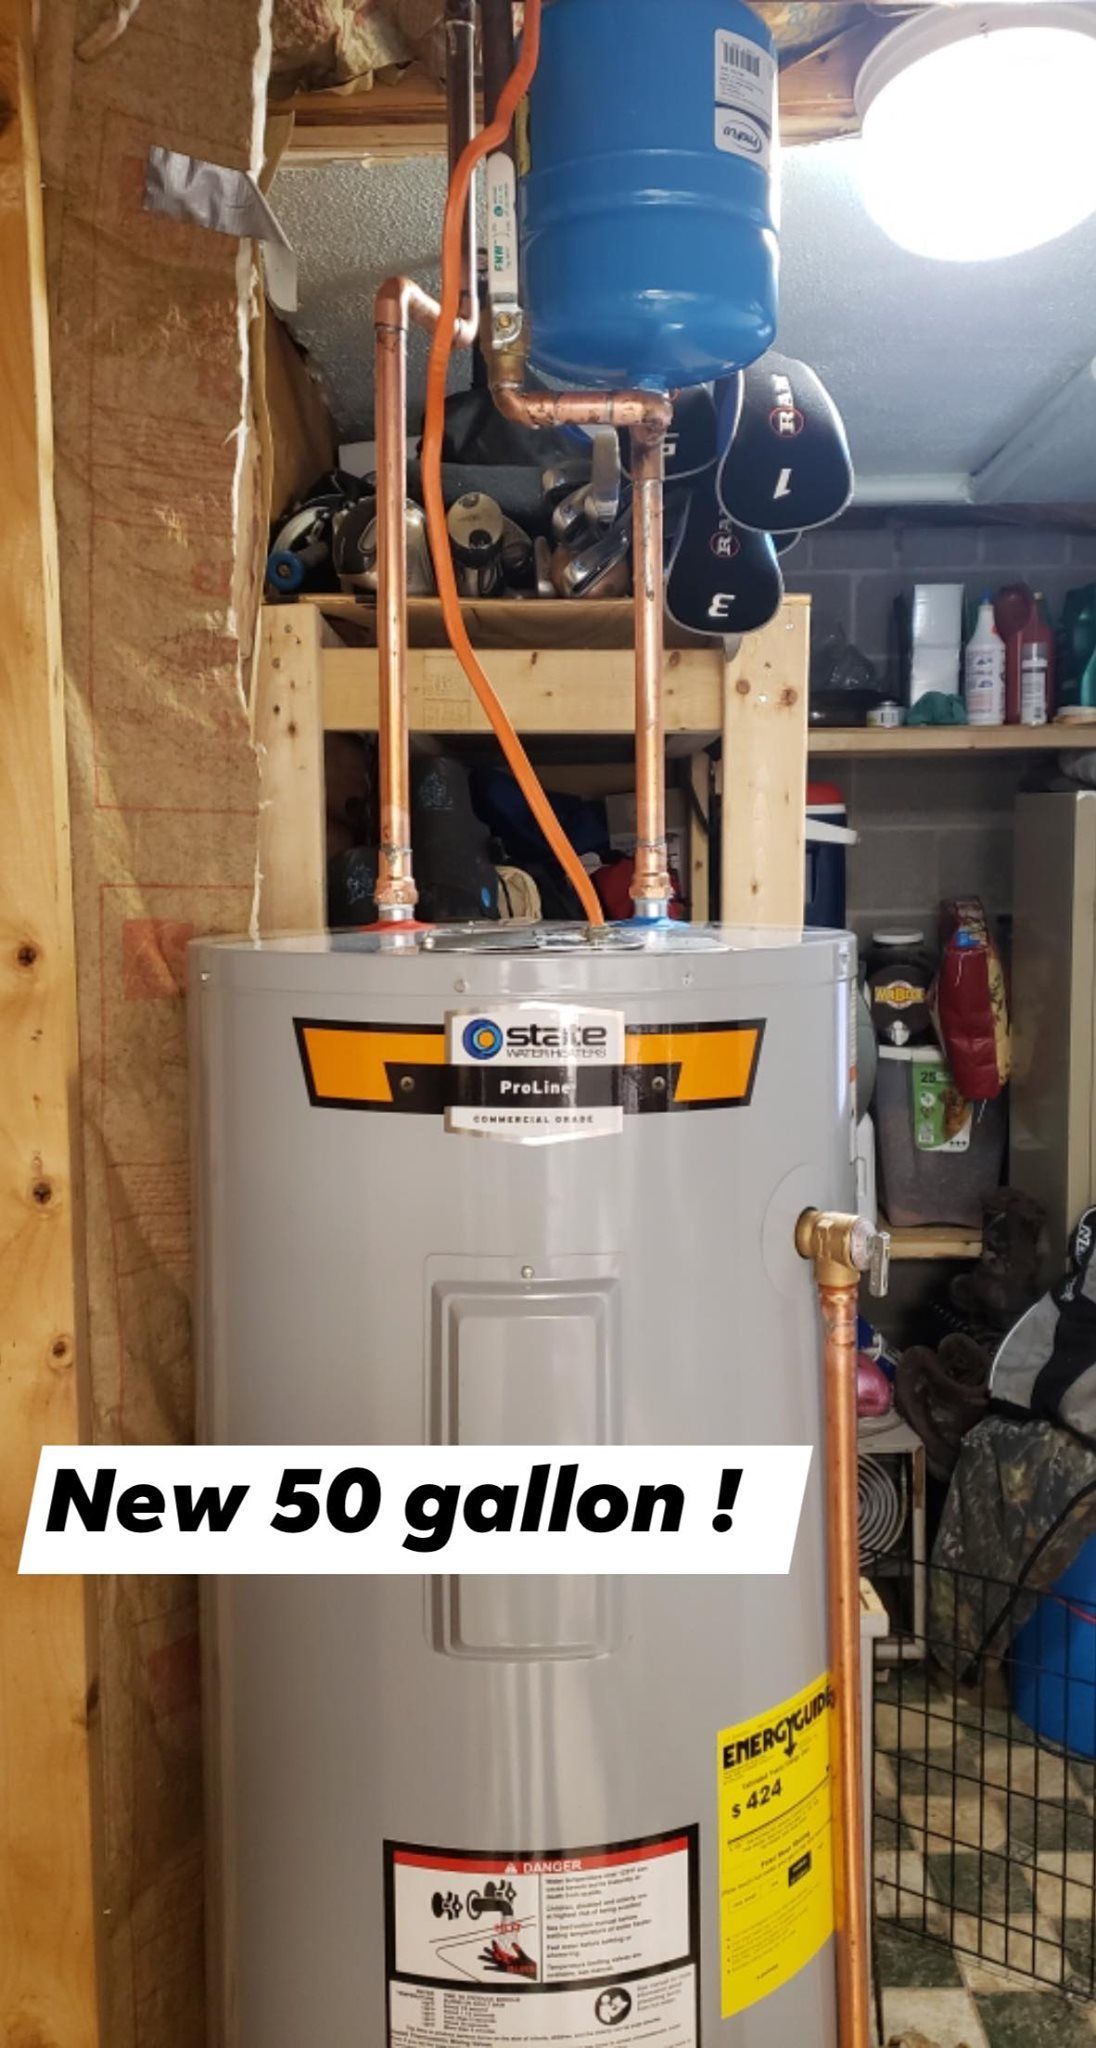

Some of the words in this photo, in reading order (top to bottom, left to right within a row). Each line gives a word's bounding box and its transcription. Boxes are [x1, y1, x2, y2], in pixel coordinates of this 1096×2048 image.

[773, 468, 793, 500] 1
[708, 592, 736, 617] 3
[506, 1024, 607, 1046] state
[500, 1079, 572, 1095] ProLine
[921, 1072, 936, 1083] 25
[473, 1114, 550, 1123] COMMERCIAL
[746, 1777, 782, 1809] 424
[523, 1860, 583, 1873] DANGER
